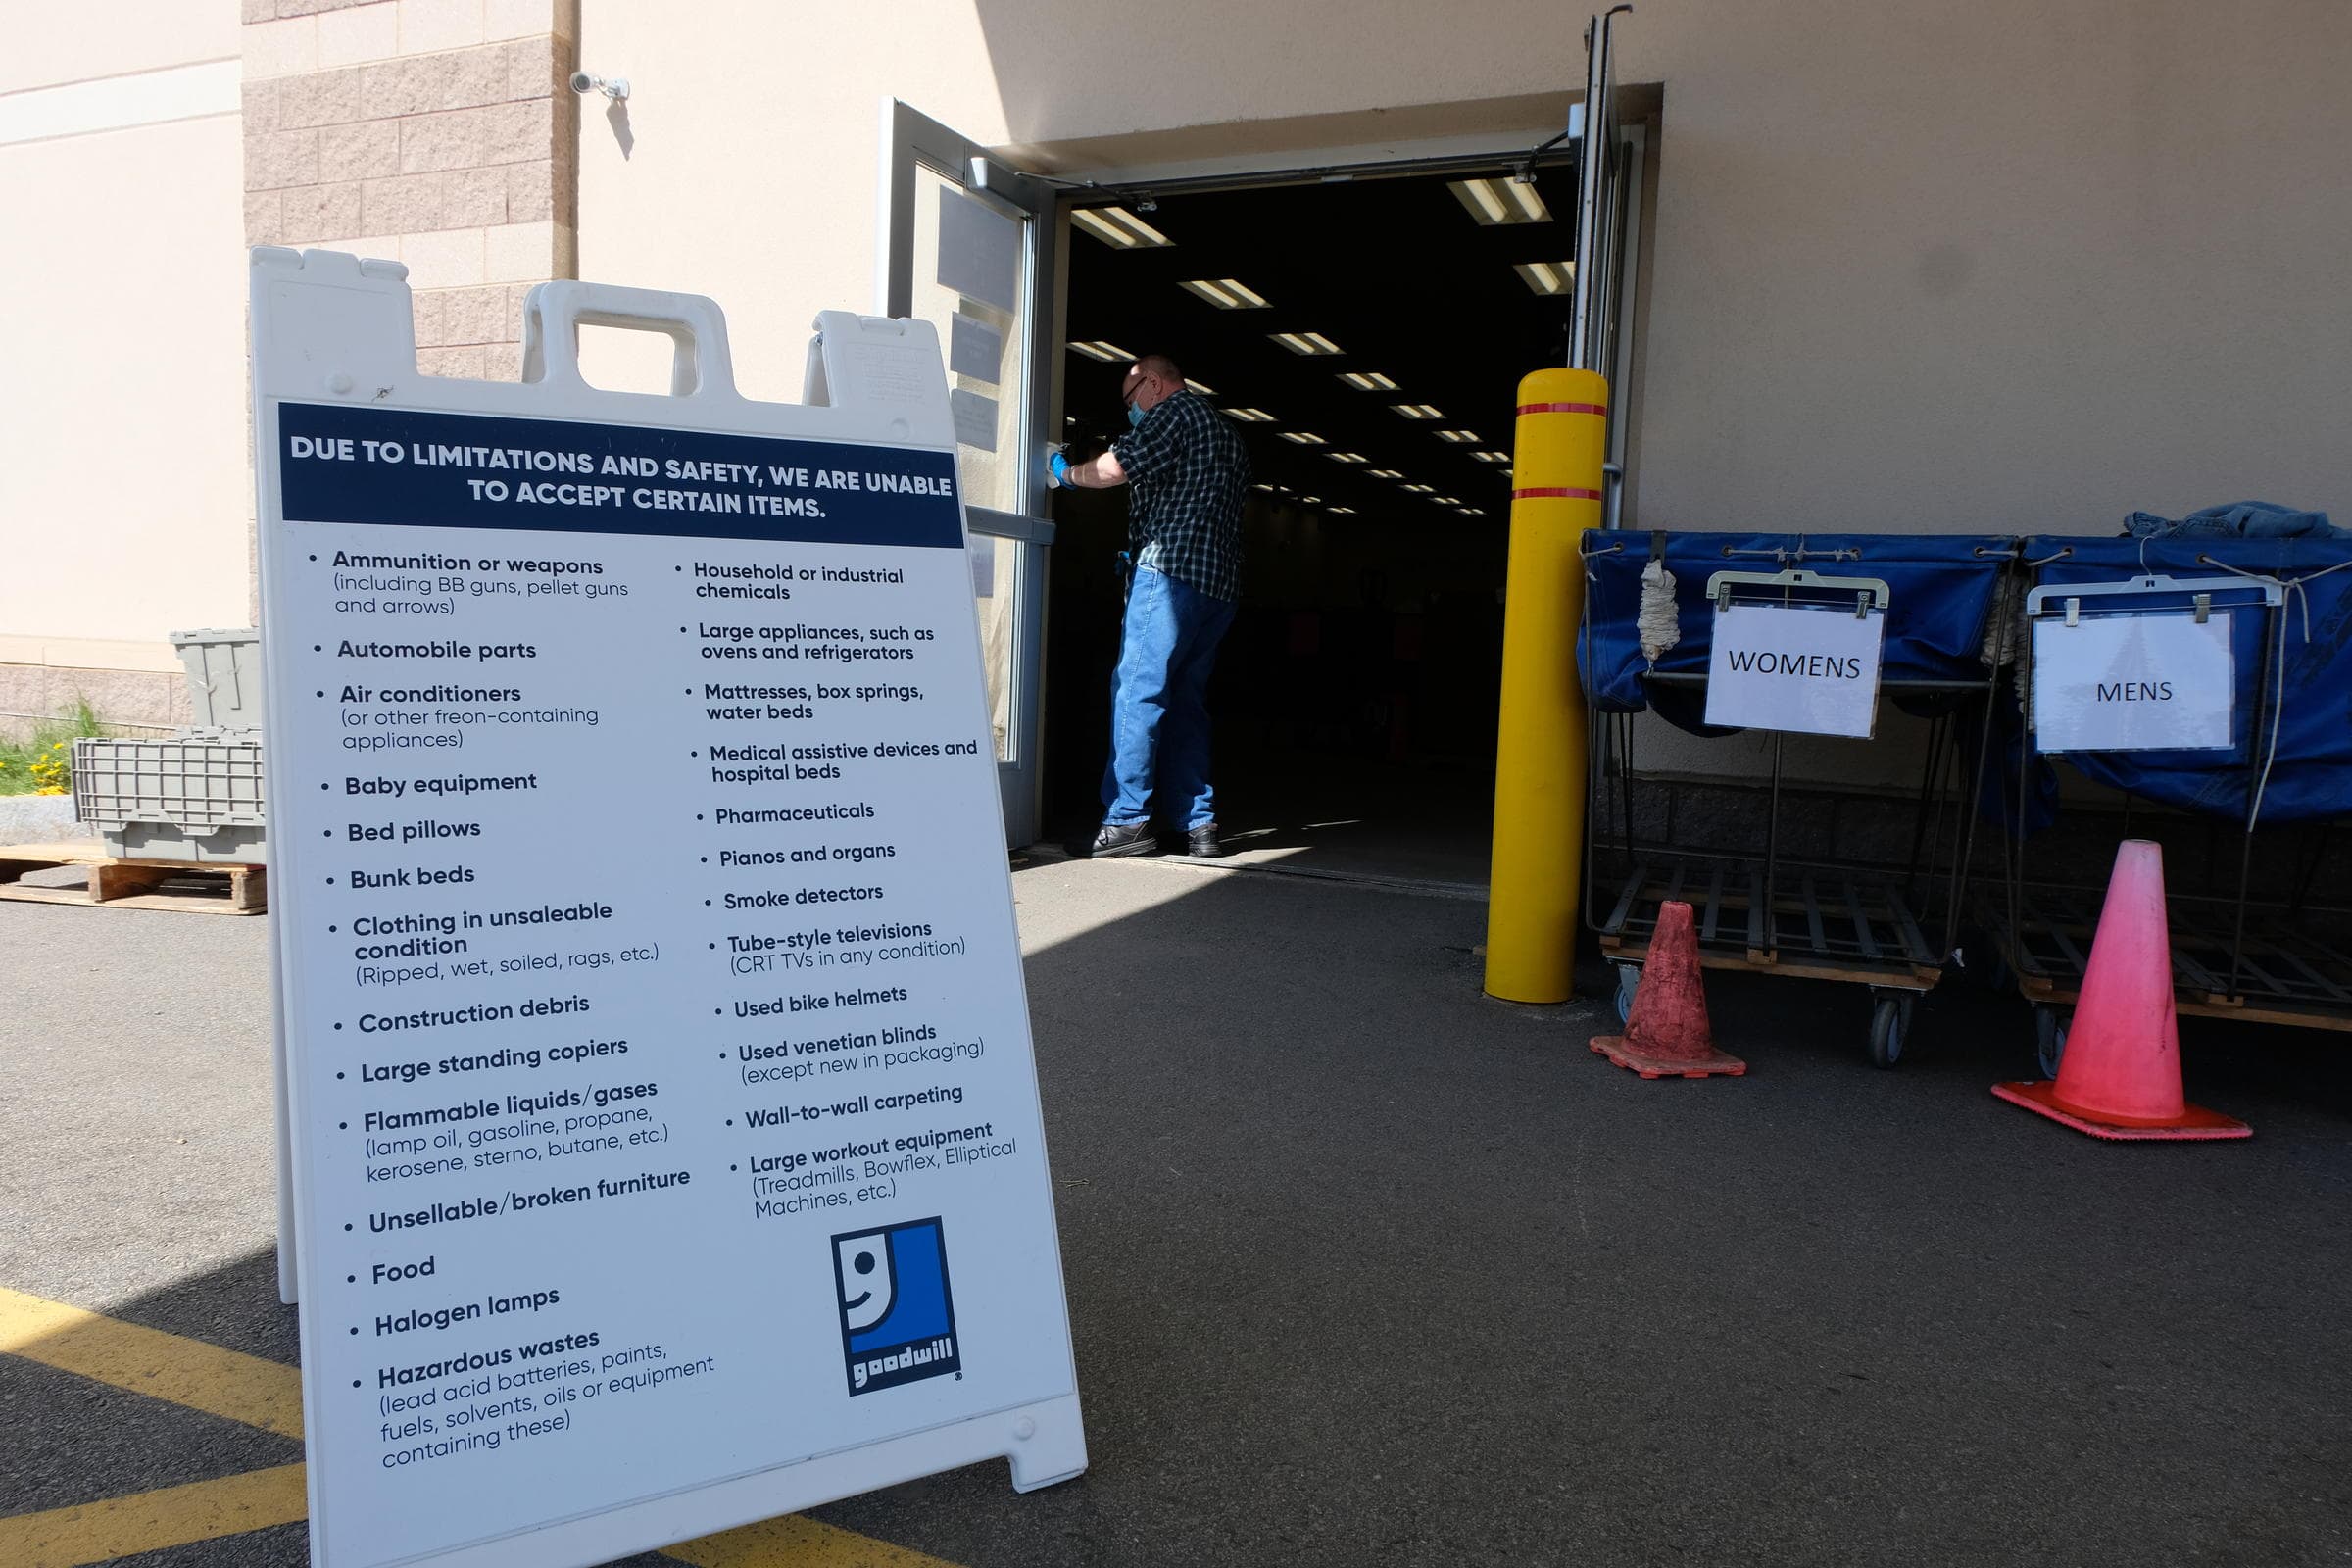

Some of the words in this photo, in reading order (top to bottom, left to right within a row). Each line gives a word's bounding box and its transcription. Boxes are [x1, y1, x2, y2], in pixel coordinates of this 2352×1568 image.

[291, 437, 354, 460] DUE
[362, 441, 404, 463] TO
[414, 444, 593, 473] LIMITATIONS
[601, 456, 658, 476] AND
[666, 460, 762, 487] SAFETY,
[769, 466, 808, 486] WE
[815, 470, 859, 490] ARE
[866, 473, 952, 496] UNABLE
[468, 480, 508, 501] TO
[516, 483, 625, 506] ACCEPT
[633, 489, 741, 513] CERTAIN
[749, 496, 825, 517] ITEMS.
[332, 551, 471, 570] Ammunition
[478, 560, 500, 571] or
[506, 560, 603, 577] weapons
[694, 562, 793, 580] Household
[799, 569, 816, 580] or
[821, 566, 904, 583] industrial
[334, 572, 431, 595] (including
[439, 577, 465, 592] BB
[470, 582, 521, 596] guns,
[527, 579, 579, 597] pellet
[585, 584, 628, 599] guns
[696, 582, 790, 600] chemicals
[335, 598, 375, 612] and
[383, 597, 454, 615] arrows)
[700, 622, 754, 642] Large
[760, 623, 864, 643] appliances,
[870, 626, 909, 640] such
[914, 629, 934, 640] as
[337, 640, 471, 658] Automobile
[479, 643, 536, 662] parts
[701, 647, 757, 659] ovens
[762, 644, 799, 659] and
[805, 644, 914, 662] refrigerators
[1729, 651, 1860, 679] WOMENS
[340, 685, 372, 703] Air
[379, 685, 521, 703] conditioners
[705, 684, 811, 702] Mattresses,
[817, 683, 851, 699] box
[856, 683, 923, 702] springs,
[2098, 682, 2172, 701] MENS
[342, 708, 368, 727] (or
[375, 710, 429, 725] other
[435, 708, 598, 725] freon-containing
[706, 706, 761, 720] water
[767, 704, 813, 719] beds
[343, 729, 463, 752] appliances)
[710, 744, 786, 761] Medical
[792, 743, 868, 760] assistive
[874, 741, 940, 757] devices
[945, 739, 977, 755] and
[346, 776, 407, 798] Baby
[414, 774, 537, 796] equipment
[712, 763, 790, 785] hospital
[795, 763, 840, 780] beds
[716, 802, 874, 824] Pharmaceuticals
[348, 822, 394, 841] Bed
[403, 820, 481, 844] pillows
[720, 850, 785, 866] Pianos
[791, 845, 827, 862] and
[833, 846, 896, 862] organs
[351, 868, 412, 889] Bunk
[417, 865, 474, 885] beds
[724, 891, 789, 909] Smoke
[795, 886, 883, 905] detectors
[353, 913, 456, 936] Clothing
[463, 910, 482, 928] in
[490, 902, 612, 926] unsaleable
[355, 937, 467, 960] condition
[727, 929, 831, 953] Tube-style
[836, 922, 932, 943] televisions
[357, 962, 444, 987] (Ripped,
[451, 959, 493, 976] wet,
[500, 953, 562, 972] soiled,
[568, 953, 614, 968] rags,
[620, 942, 659, 961] etc.)
[731, 955, 775, 976] (CRT
[780, 952, 813, 969] TVs
[818, 951, 834, 966] in
[840, 950, 872, 965] any
[879, 936, 964, 960] condition)
[359, 1004, 513, 1033] Construction
[520, 995, 589, 1017] debris
[735, 997, 784, 1017] Used
[789, 994, 829, 1012] bike
[835, 987, 907, 1007] helmets
[739, 1040, 788, 1061] Used
[793, 1033, 877, 1055] venetian
[882, 1024, 936, 1045] blinds
[362, 1062, 431, 1083] Large
[439, 1049, 541, 1074] standing
[548, 1039, 628, 1062] copiers
[742, 1061, 814, 1086] (except
[820, 1058, 858, 1074] new
[863, 1053, 878, 1068] in
[884, 1036, 983, 1070] packaging)
[365, 1099, 500, 1132] Flammable
[507, 1083, 658, 1116] liquids/gases
[745, 1096, 868, 1128] Wall-to-wall
[874, 1086, 962, 1110] carpeting
[367, 1138, 426, 1159] (lamp
[434, 1129, 462, 1148] oil,
[468, 1120, 559, 1148] gasoline,
[565, 1108, 652, 1135] propane,
[751, 1153, 807, 1173] Large
[811, 1139, 889, 1163] workout
[895, 1122, 993, 1152] equipment
[368, 1158, 466, 1183] kerosene,
[474, 1148, 541, 1167] sterno,
[549, 1136, 622, 1157] butane,
[629, 1123, 667, 1145] etc.)
[754, 1165, 858, 1198] (Treadmills,
[864, 1154, 940, 1178] Bowflex,
[946, 1138, 1016, 1165] Elliptical
[369, 1187, 591, 1233] Unsellable/broken
[597, 1171, 690, 1198] furniture
[756, 1192, 852, 1219] Machines,
[858, 1177, 896, 1200] etc.)
[373, 1255, 435, 1285] Food
[376, 1304, 480, 1337] Halogen
[488, 1290, 560, 1315] lamps
[378, 1349, 512, 1389] Hazardous
[518, 1332, 600, 1359] wastes
[853, 1337, 953, 1389] goodwill
[380, 1388, 436, 1417] (lead
[444, 1376, 490, 1401] acid
[498, 1360, 595, 1391] batteries,
[602, 1345, 666, 1373] paints,
[381, 1416, 438, 1442] fuels,
[446, 1397, 537, 1428] solvents,
[544, 1385, 576, 1405] oils
[583, 1382, 602, 1397] or
[609, 1356, 714, 1393] equipment
[383, 1431, 500, 1468] containing
[507, 1408, 570, 1440] these)
